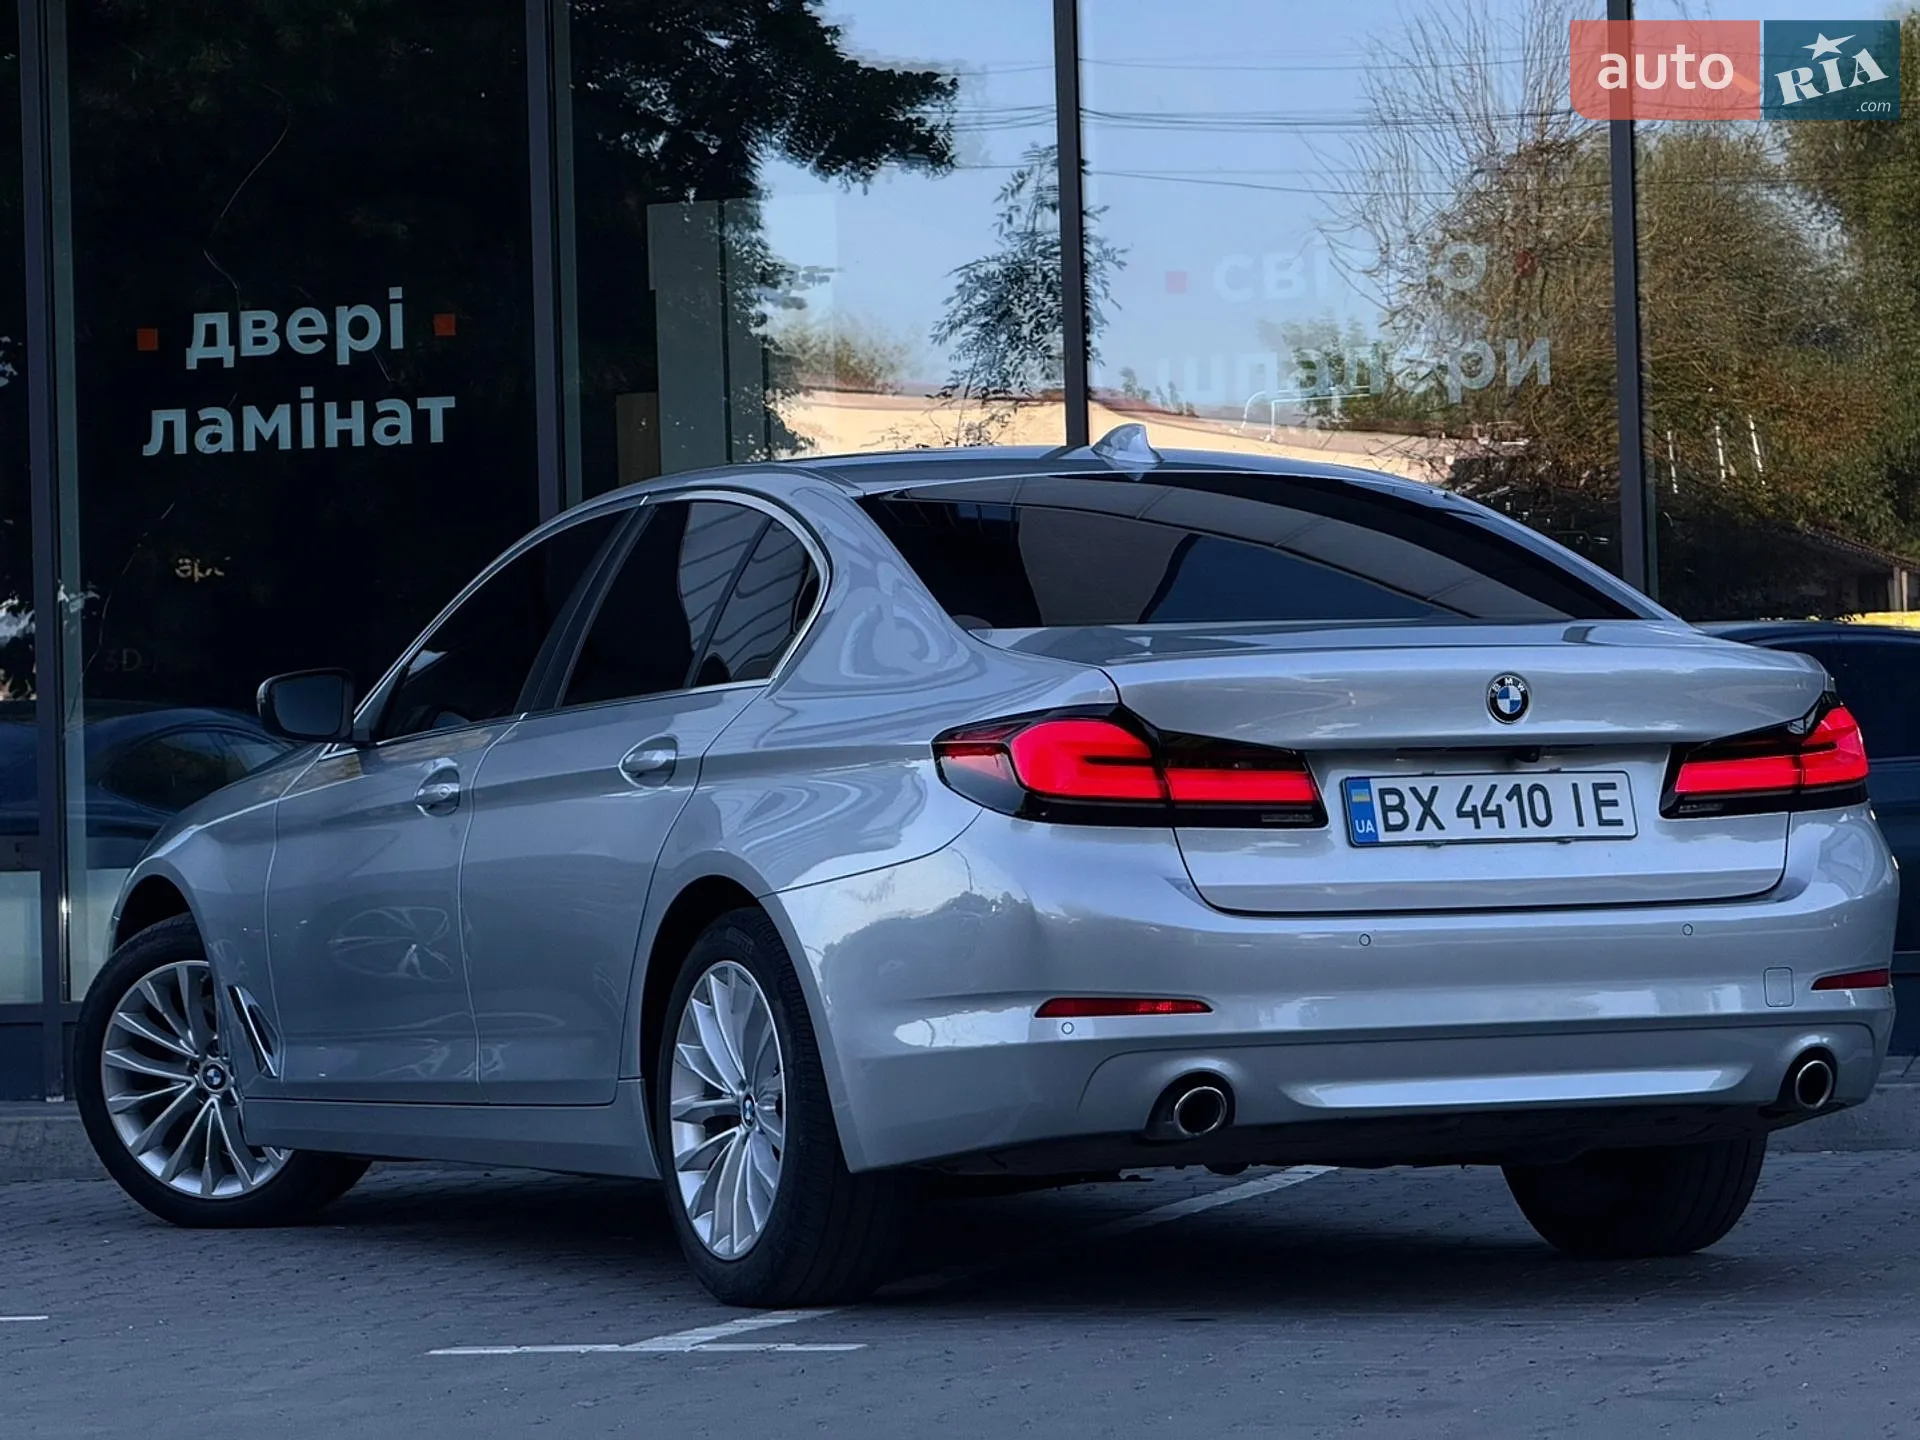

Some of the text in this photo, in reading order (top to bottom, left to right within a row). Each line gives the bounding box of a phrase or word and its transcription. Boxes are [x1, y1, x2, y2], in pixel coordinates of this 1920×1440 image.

[1212, 236, 1488, 302] свіо
[186, 286, 404, 370] двері
[142, 386, 456, 457] ламінат
[1355, 819, 1376, 835] UA
[1378, 781, 1625, 833] BX 4410 IE
